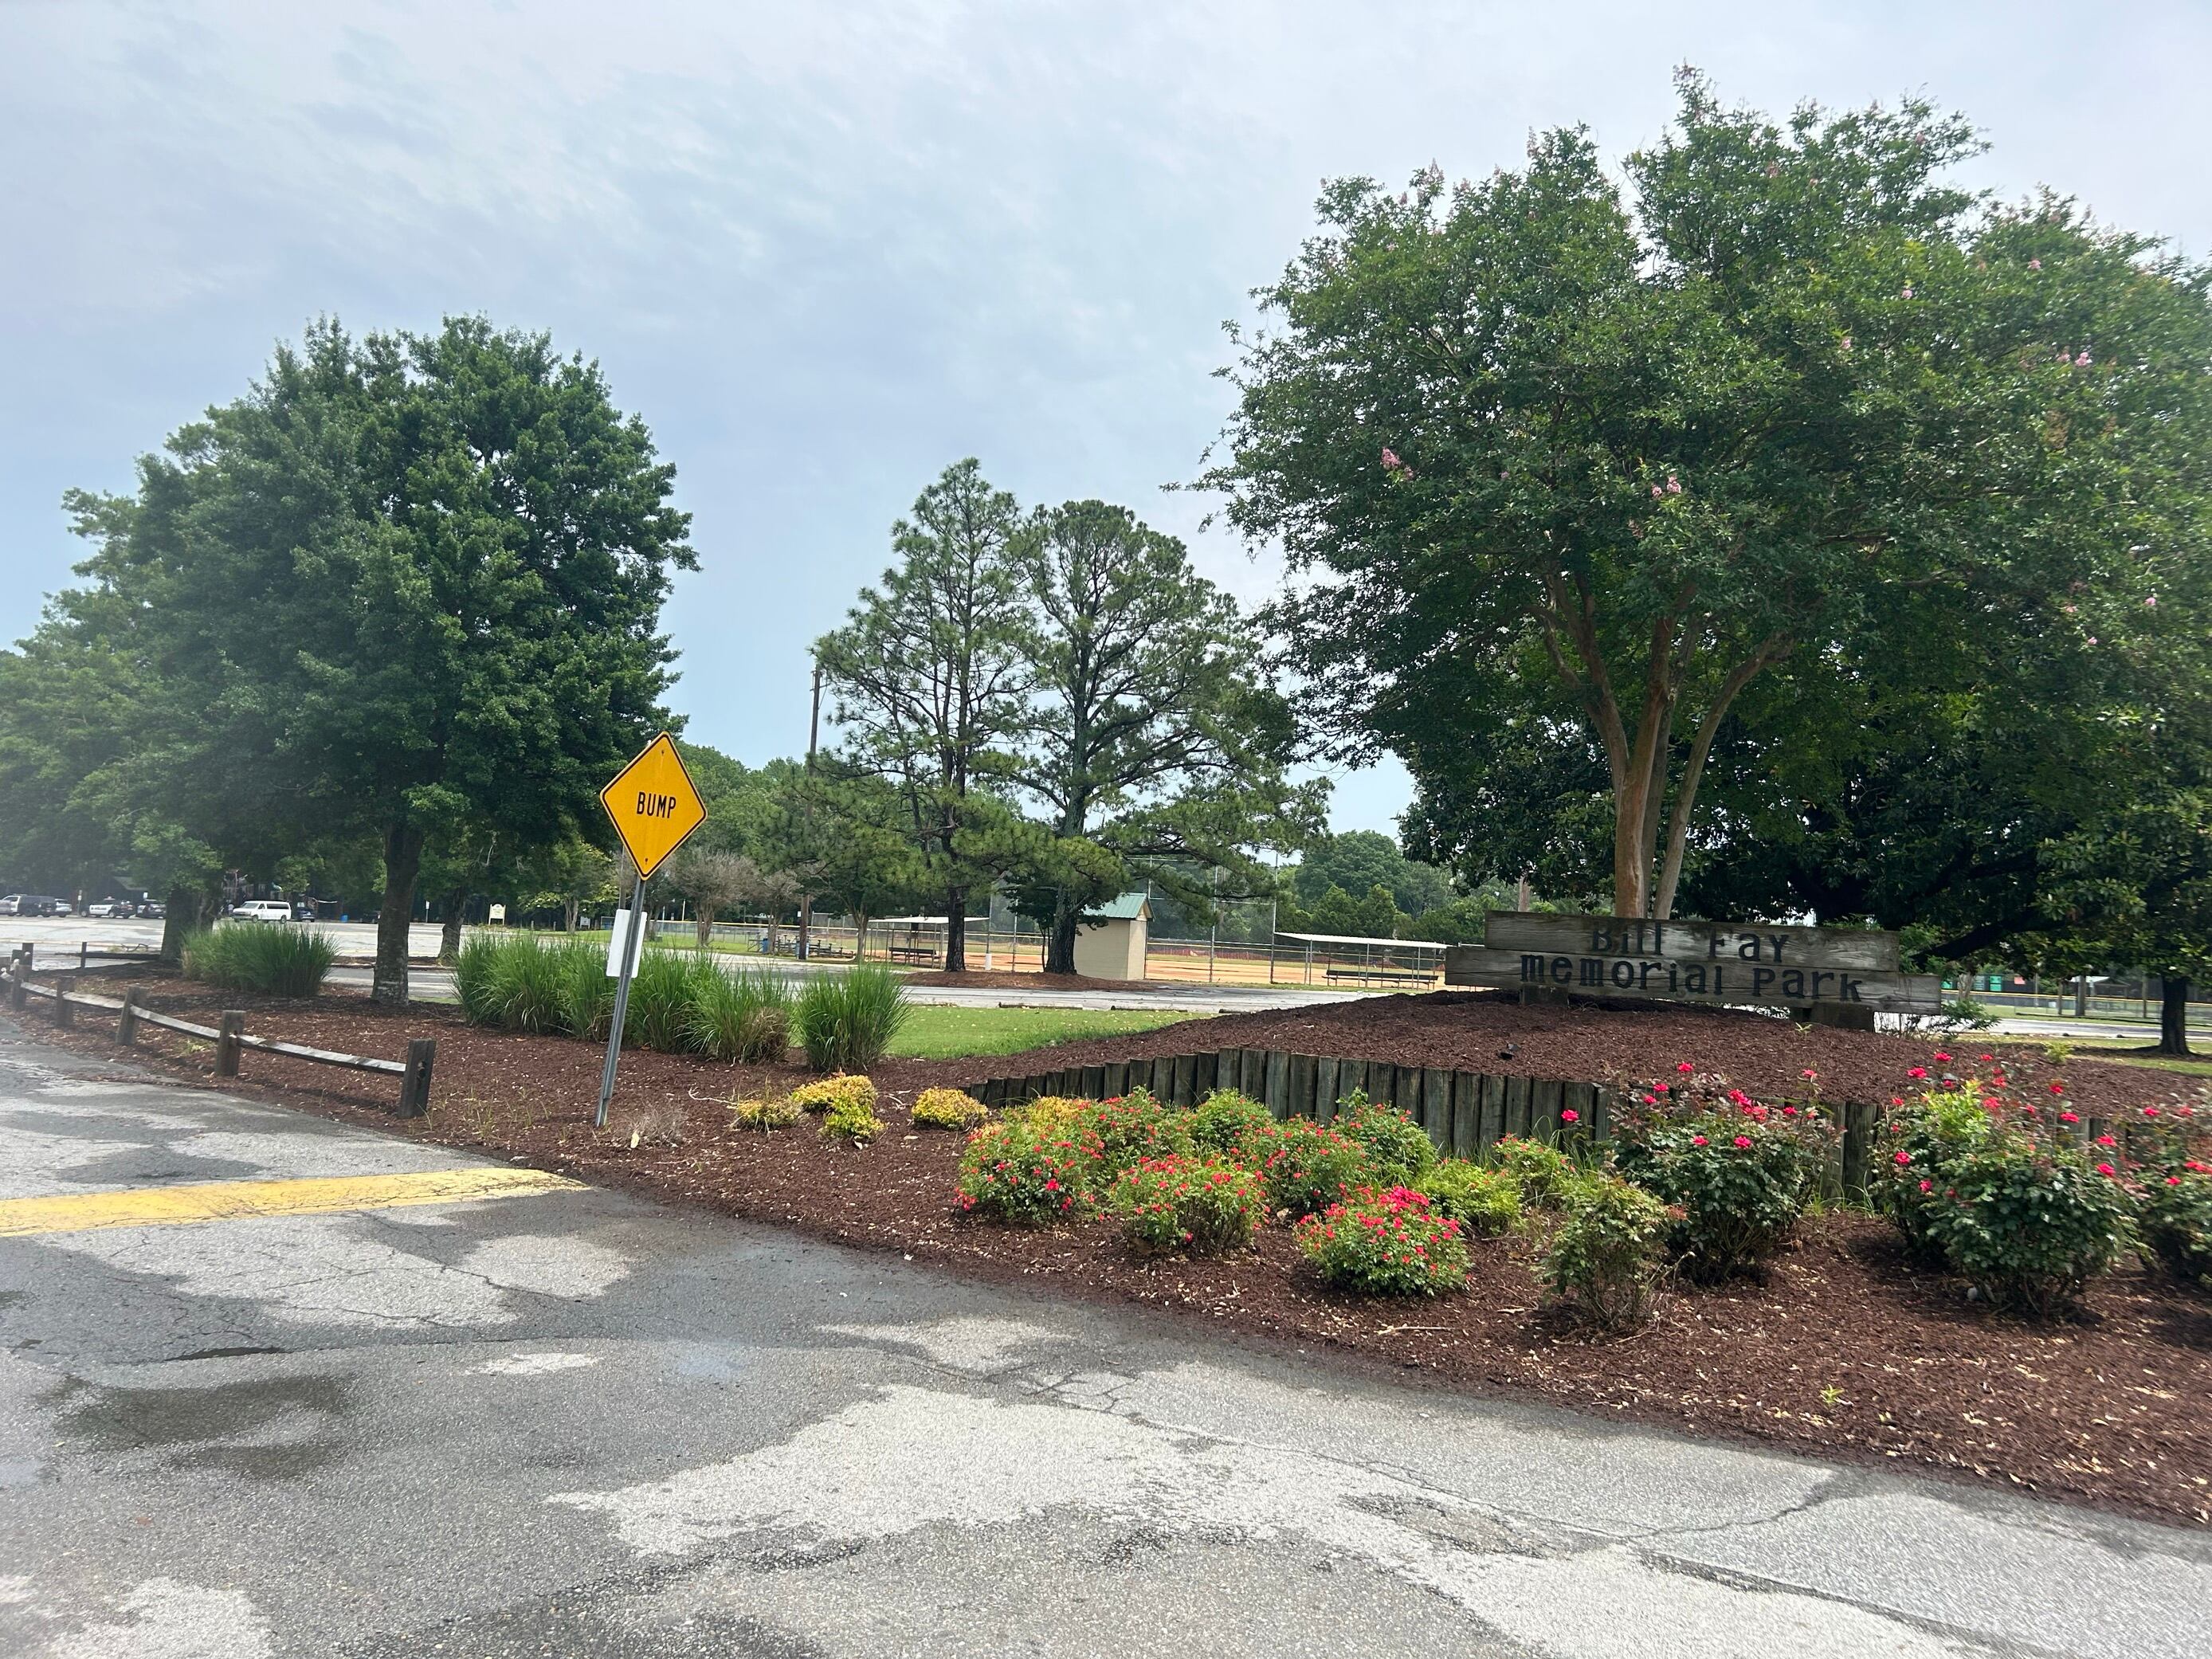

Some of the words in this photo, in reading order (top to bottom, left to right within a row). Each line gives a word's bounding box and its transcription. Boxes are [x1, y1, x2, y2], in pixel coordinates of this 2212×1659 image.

[637, 791, 676, 818] BUMP
[1592, 924, 1663, 955] Bill
[1752, 967, 1862, 1002] Park
